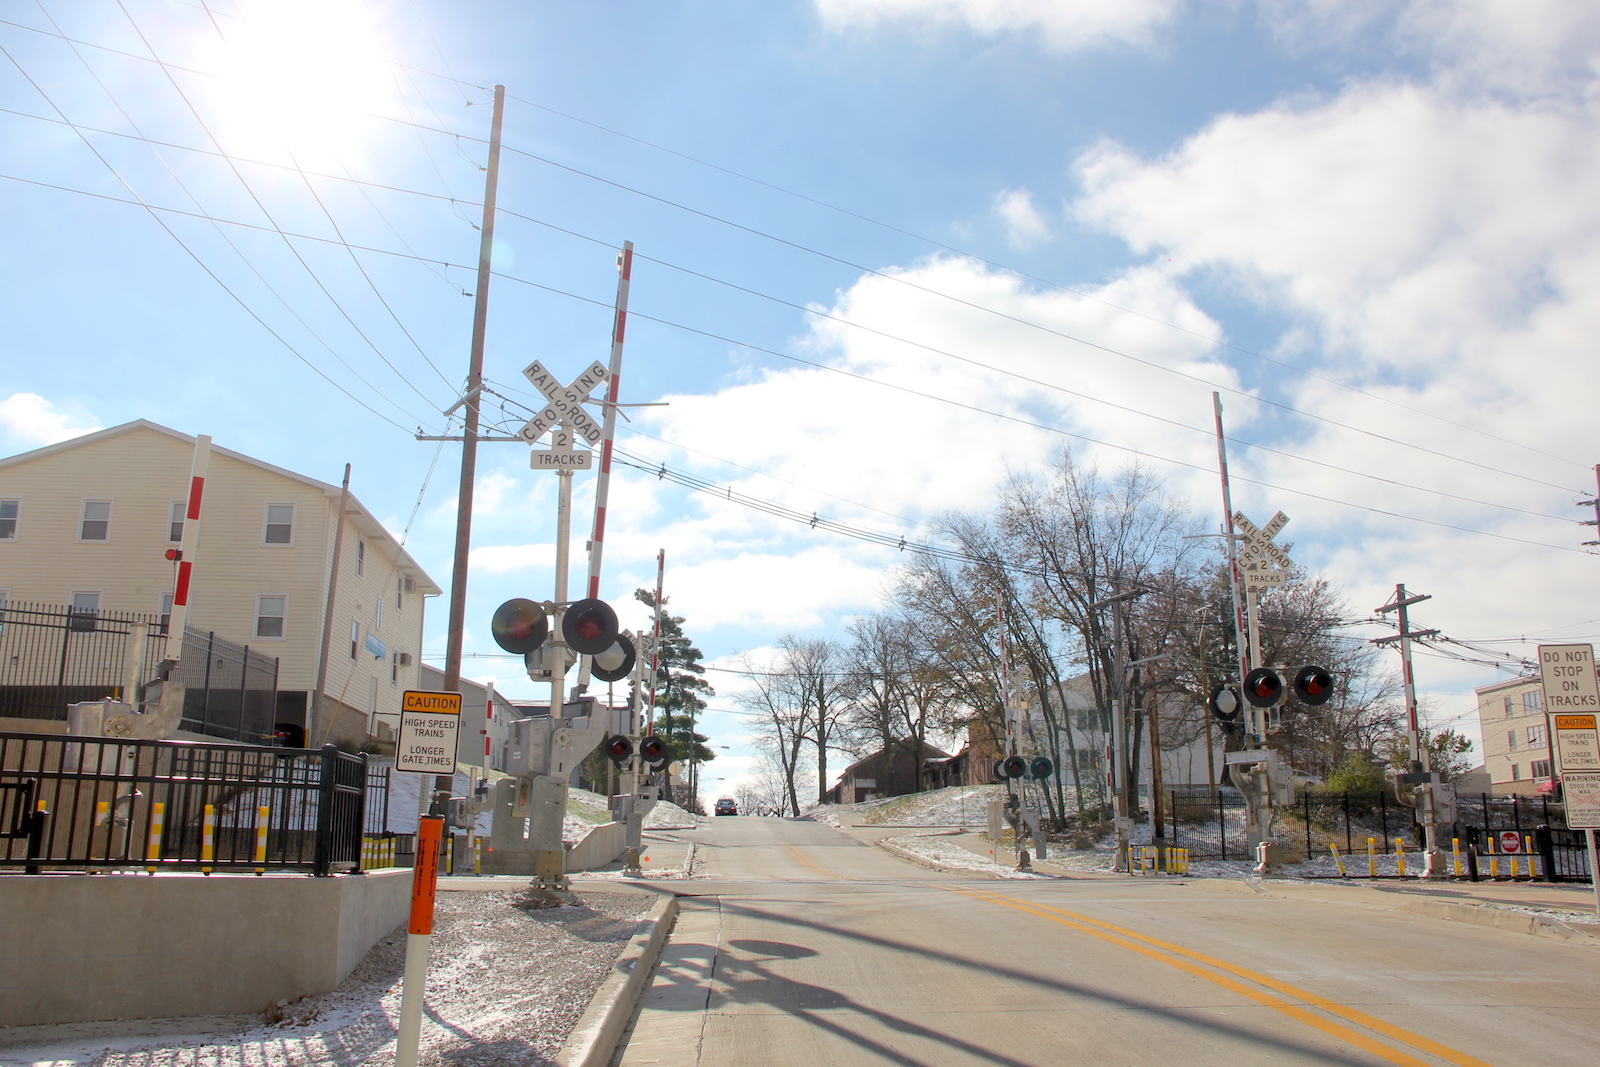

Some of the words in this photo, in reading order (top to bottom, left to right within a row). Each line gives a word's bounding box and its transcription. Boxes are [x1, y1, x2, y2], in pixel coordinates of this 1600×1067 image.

[557, 433, 567, 447] 2
[538, 454, 584, 465] TRACKS
[1260, 560, 1268, 570] 2
[1249, 574, 1281, 583] TRACKS
[1543, 652, 1560, 663] DO
[1565, 651, 1588, 662] NOT
[1553, 666, 1583, 677] STOP
[1562, 681, 1579, 691] ON
[407, 696, 457, 709] CAUTION
[1549, 695, 1597, 706] TRACKS
[404, 718, 426, 727] HIGH
[428, 719, 455, 729] SPEED
[1558, 718, 1594, 726] CAUTION
[414, 728, 445, 738] TRAINS
[410, 746, 445, 756] LONGER
[402, 755, 424, 764] GATE
[426, 756, 451, 766] TIMES
